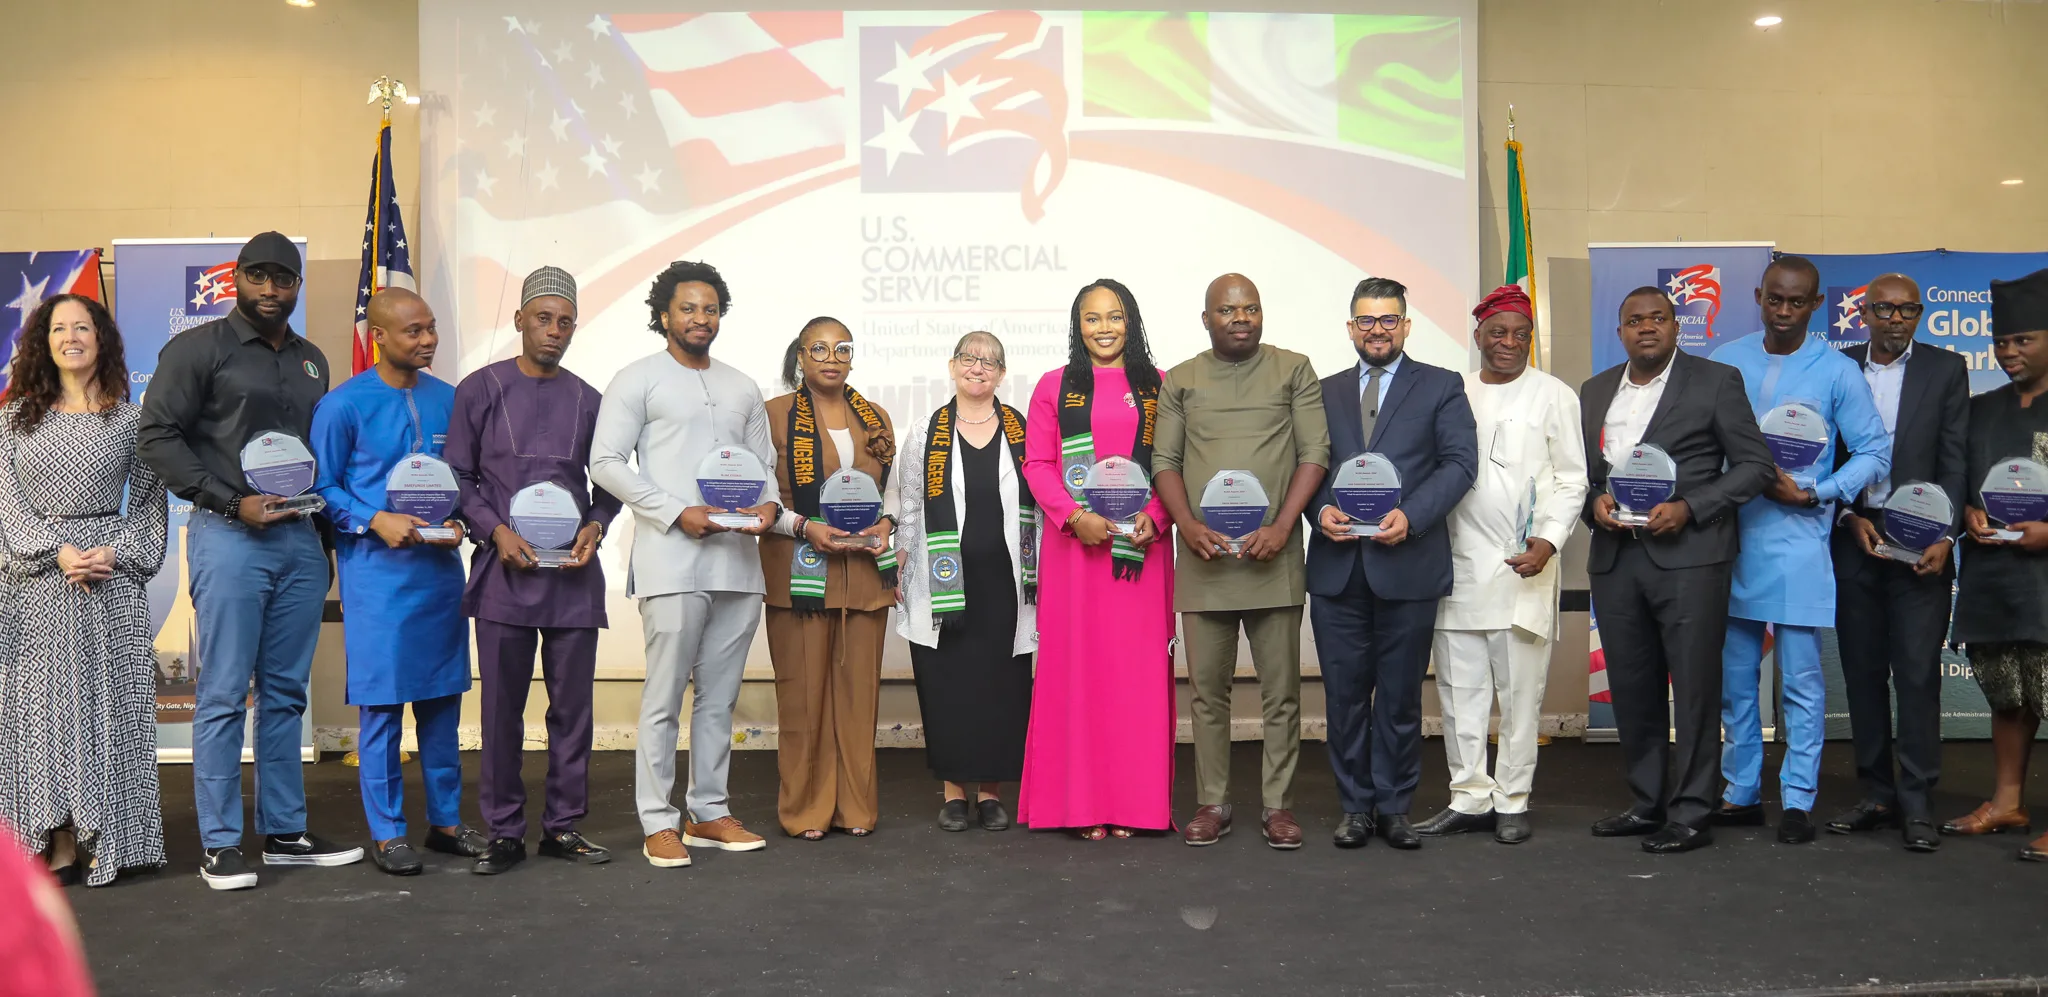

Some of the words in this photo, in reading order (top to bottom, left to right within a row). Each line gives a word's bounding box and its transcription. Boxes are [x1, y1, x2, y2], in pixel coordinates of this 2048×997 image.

[861, 216, 915, 243] U.S.
[861, 244, 1068, 273] COMMERCIAL
[861, 275, 981, 303] SERVICE
[862, 319, 920, 337] United
[925, 318, 974, 336] States
[1000, 317, 1068, 336] America
[793, 435, 815, 487] NIGERIA.
[927, 450, 949, 501] NIGERIA.
